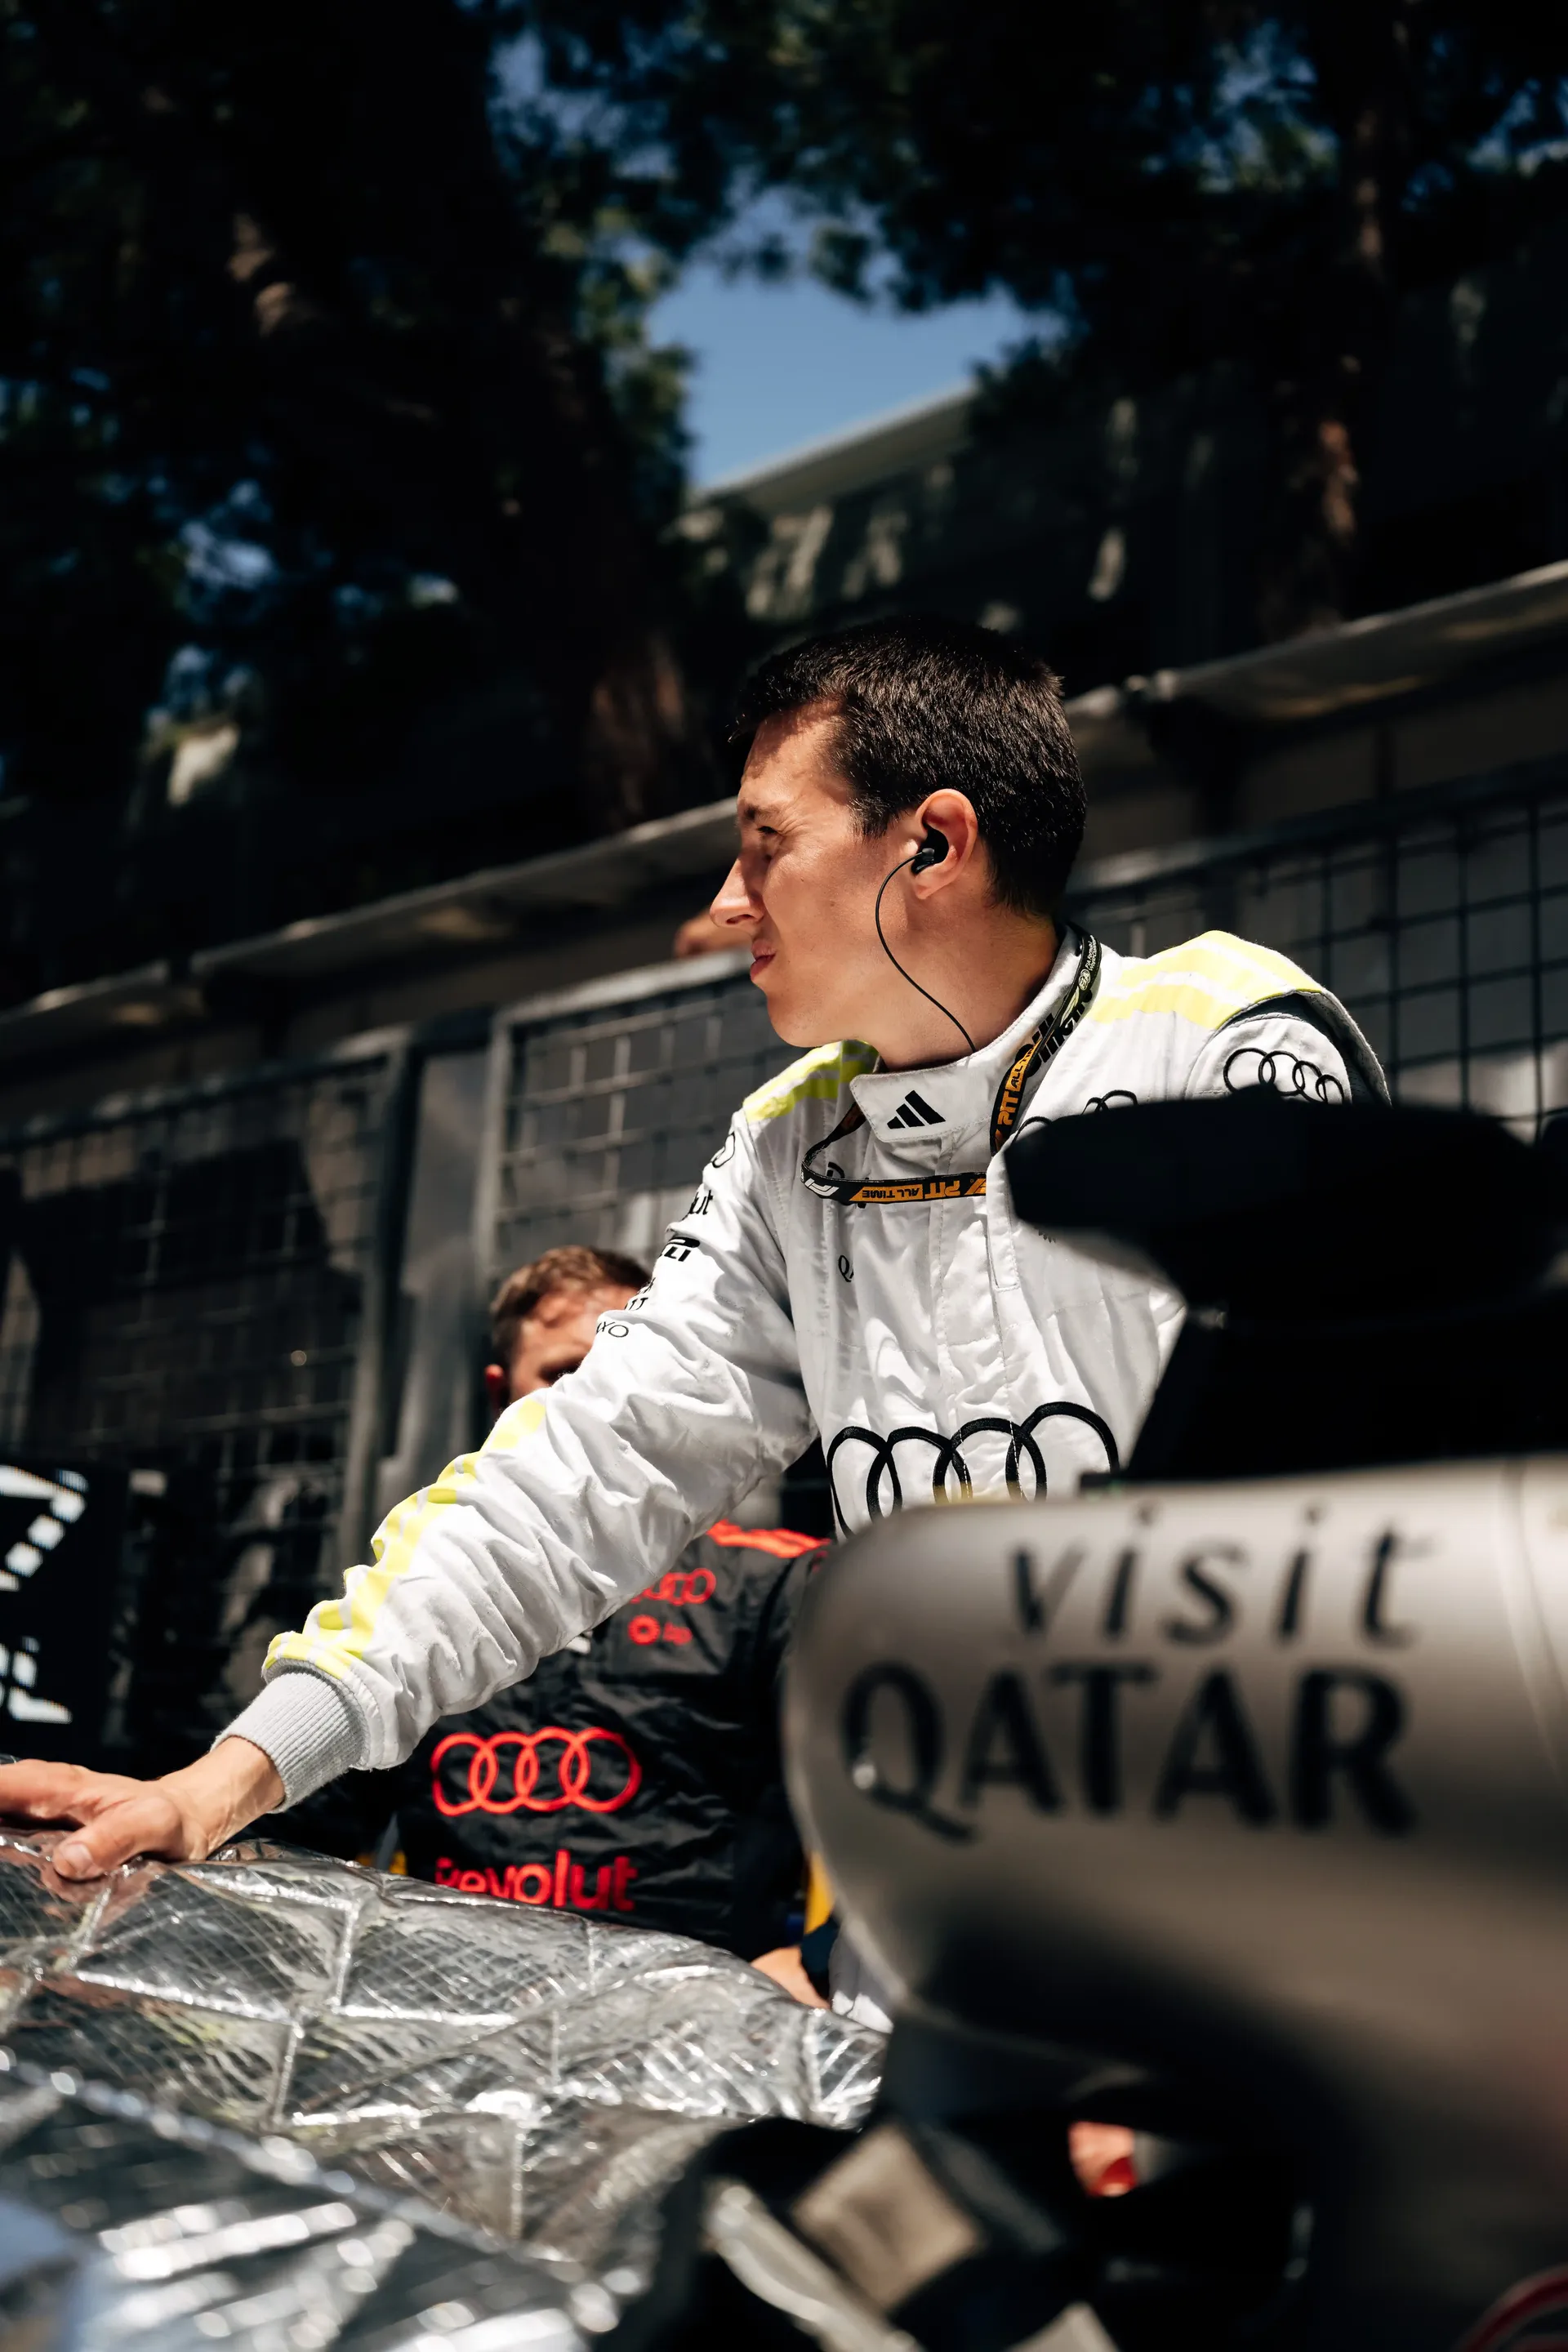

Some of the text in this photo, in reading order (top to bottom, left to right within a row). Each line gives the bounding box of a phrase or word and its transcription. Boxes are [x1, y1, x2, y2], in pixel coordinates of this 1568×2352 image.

[997, 1090, 1018, 1126] PIT
[1011, 1065, 1023, 1089] ALL
[862, 1189, 896, 1199] TIME
[899, 1187, 920, 1198] ALL
[924, 1180, 960, 1199] PIT
[1013, 1503, 1436, 1648] visit
[841, 1660, 1419, 1844] QATAR
